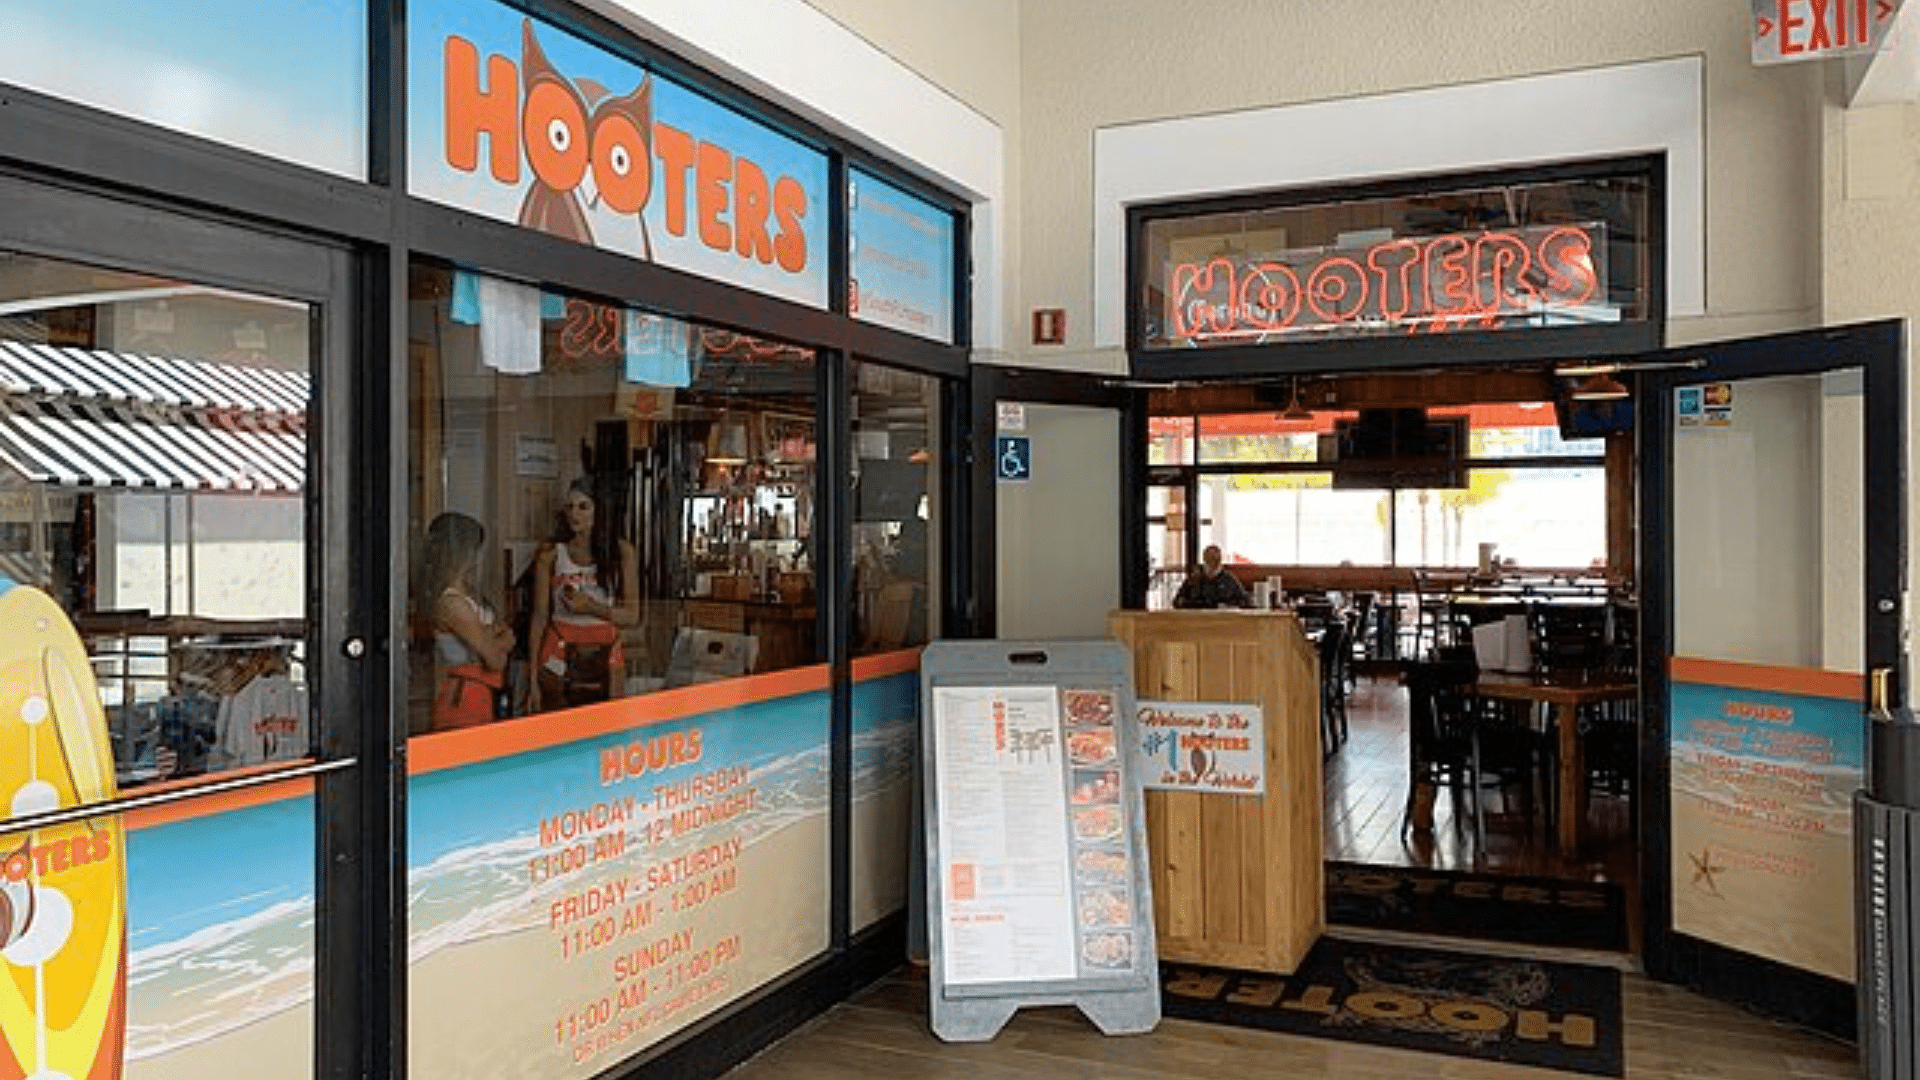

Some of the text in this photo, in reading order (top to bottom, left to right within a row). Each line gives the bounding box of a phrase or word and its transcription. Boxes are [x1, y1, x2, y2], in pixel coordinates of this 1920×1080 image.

[445, 34, 806, 273] HOOTERS
[1173, 227, 1597, 337] HOOTERS
[601, 729, 703, 785] HOURS
[1137, 707, 1205, 727] Welcome
[1181, 733, 1250, 751] HOOTERS
[528, 845, 586, 883] 11:00
[594, 829, 625, 861] AM
[646, 818, 667, 844] 12
[671, 786, 758, 836] MIDNIGHT
[539, 797, 636, 848] MONDAY
[654, 765, 751, 811] THURSDAY
[0, 828, 111, 883] OTERS
[551, 878, 628, 930] FRIDAY
[648, 836, 742, 893] SATURDAY
[562, 917, 615, 964] 11:00
[621, 899, 654, 935] AM
[671, 882, 706, 913] 1:00
[711, 866, 738, 896] AM
[614, 927, 695, 982] SUNDAY
[556, 998, 611, 1048] 11:00
[618, 977, 647, 1014] AM
[665, 950, 711, 991] 11:00
[714, 935, 741, 966] PM
